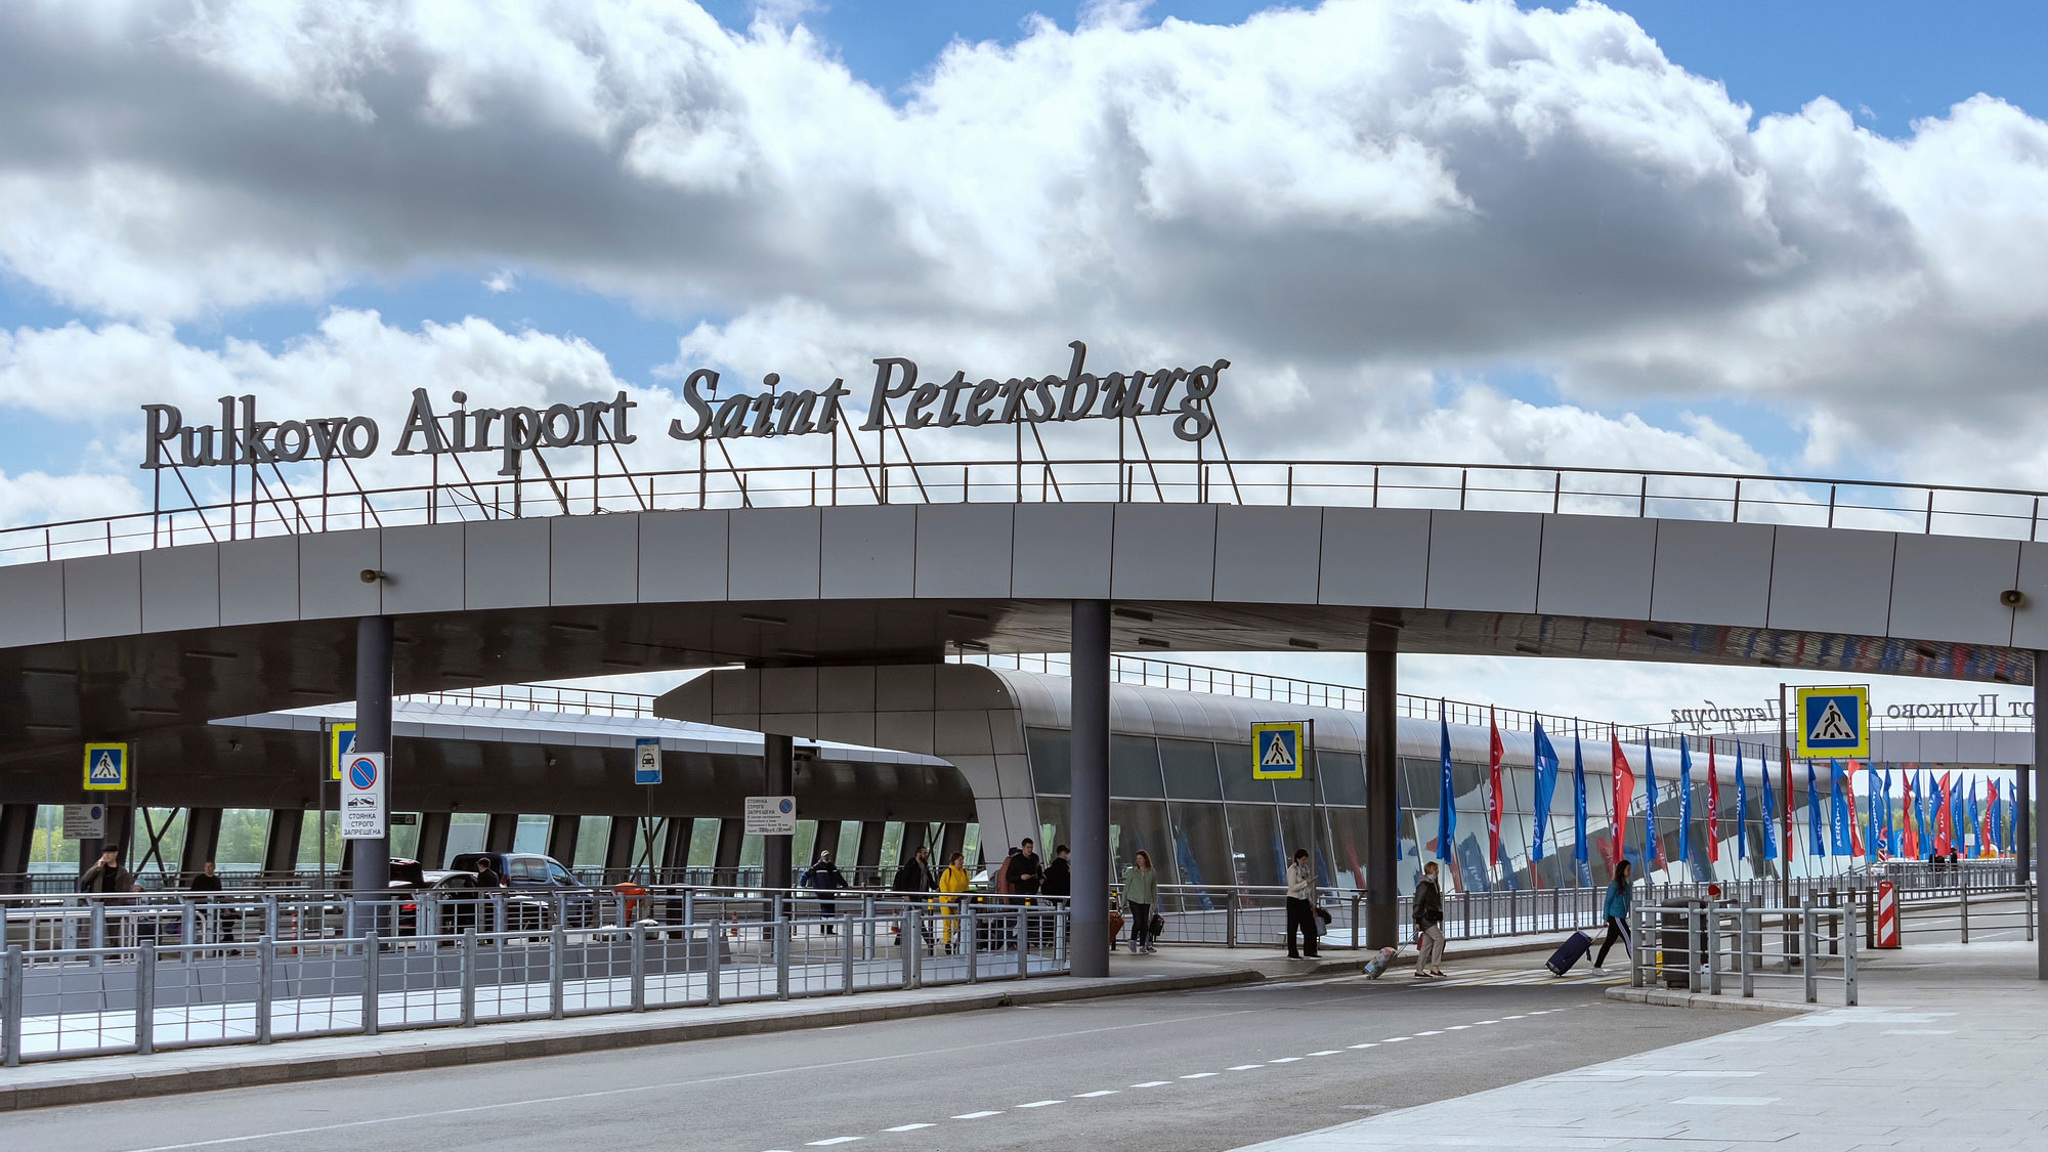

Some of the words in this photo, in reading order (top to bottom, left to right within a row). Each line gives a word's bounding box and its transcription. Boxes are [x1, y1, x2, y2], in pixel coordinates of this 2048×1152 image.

[140, 394, 379, 470] Pulkovo
[391, 387, 638, 476] Airport
[668, 368, 851, 441] Saint
[859, 340, 1232, 442] Petersburg
[351, 820, 375, 828] СТРОГО
[343, 828, 382, 836] ЗАПРЕЩЕНА
